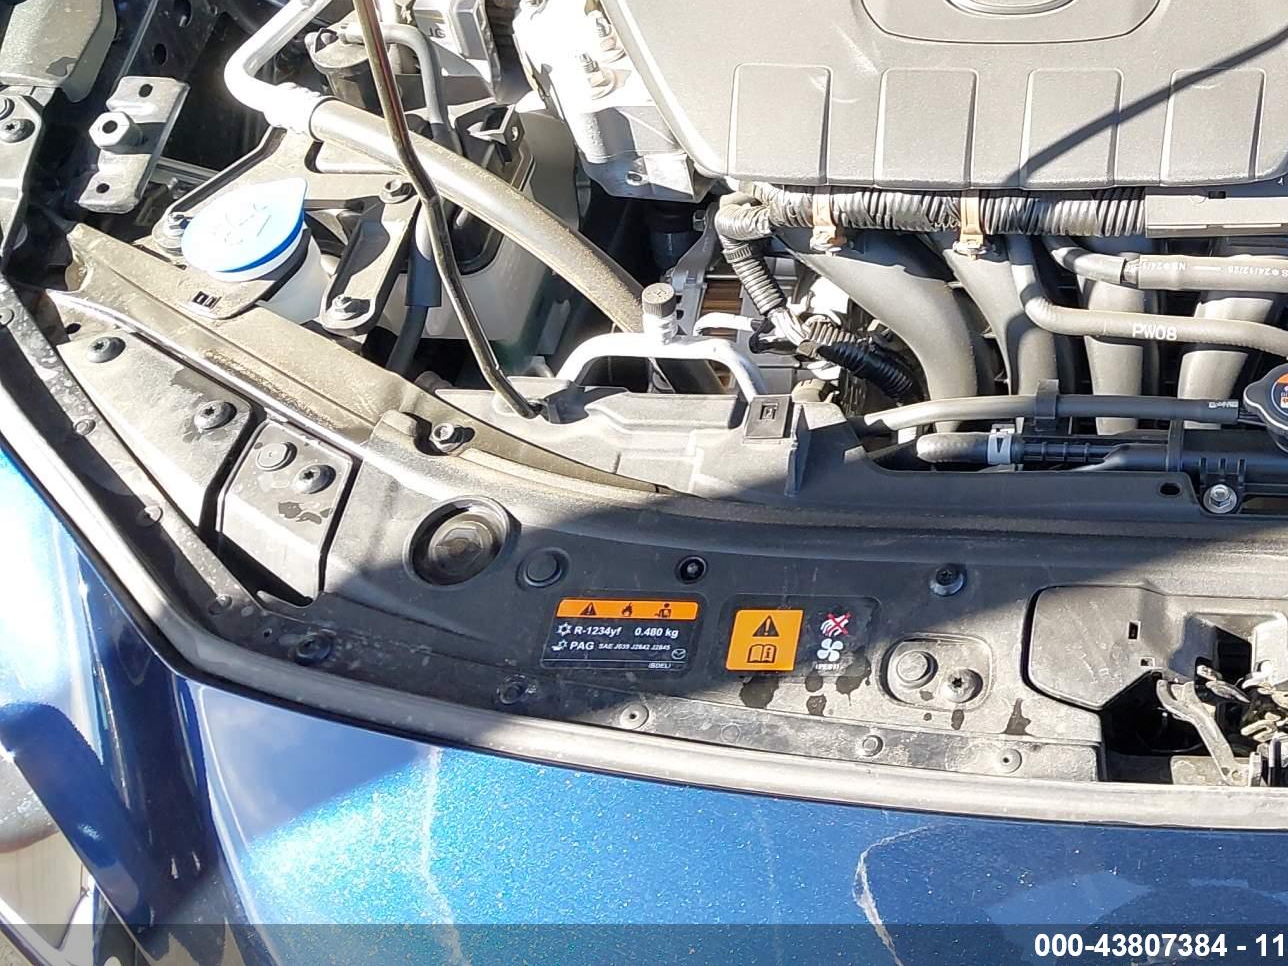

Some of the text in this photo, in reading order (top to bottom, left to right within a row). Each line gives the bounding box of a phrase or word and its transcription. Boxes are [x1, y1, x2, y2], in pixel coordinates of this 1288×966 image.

[1132, 323, 1178, 341] PW08
[573, 626, 679, 638] R-1234yf 0.480 kg
[569, 641, 595, 650] PAG
